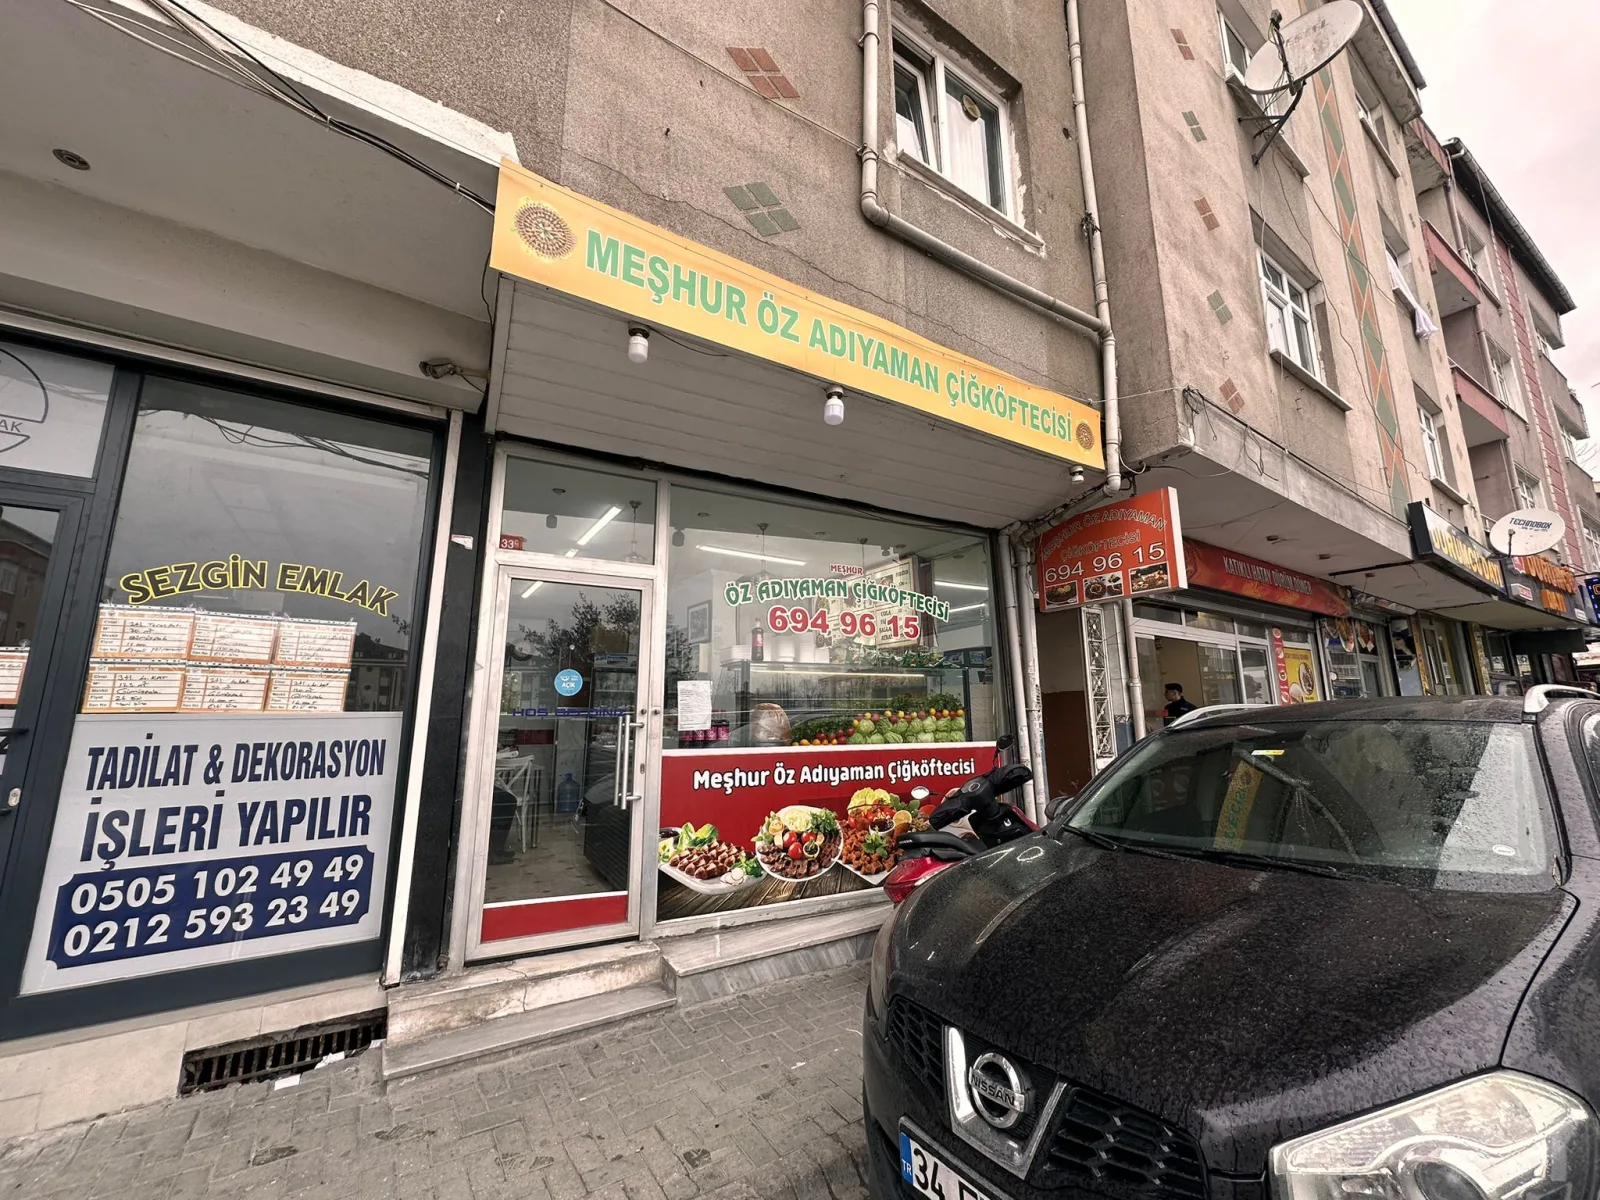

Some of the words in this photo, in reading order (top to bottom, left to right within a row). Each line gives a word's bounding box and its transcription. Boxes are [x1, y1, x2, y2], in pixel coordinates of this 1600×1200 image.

[586, 229, 748, 325] MEŞHUR
[757, 291, 800, 343] ÖZ
[808, 317, 940, 394] ADIYAMAN
[946, 369, 1073, 442] ÇİĞKÖFTECİSİ
[1043, 522, 1083, 560] MEŞHUR
[1083, 513, 1100, 528] ÖZ
[1101, 509, 1165, 532] ADIYAMAN
[1510, 518, 1552, 530] TECHNOBOX
[830, 564, 863, 576] MEŞHUR
[1045, 561, 1084, 582] 694
[1092, 552, 1123, 572] 96
[1133, 542, 1165, 563] 15
[1223, 556, 1251, 579] KATIKLI
[1251, 565, 1272, 584] HATAY
[119, 554, 268, 604] SEZGİN
[277, 563, 399, 616] EMLAK
[724, 581, 752, 607] ÖZ
[757, 578, 848, 602] ADIYAMAN
[851, 580, 950, 623] ÇİĞKÖFTECİSİ
[768, 606, 829, 635] 694
[839, 610, 876, 638] 96
[886, 614, 920, 641] 15
[512, 708, 548, 719] HOŞ
[86, 733, 198, 790] TADİLAT
[203, 744, 223, 785] &
[231, 739, 386, 784] DEKORASYON
[693, 769, 770, 795] Meşhur
[774, 762, 795, 785] Öz
[800, 759, 884, 786] Adıyaman
[888, 757, 975, 784] Çiğköftecisi
[80, 790, 225, 870] İŞLERİ
[237, 794, 372, 847] YAPILIR
[71, 874, 175, 915] 0505
[193, 866, 257, 898] 102
[270, 859, 313, 888] 49
[323, 854, 364, 882] 49
[63, 914, 170, 957] 0212
[183, 903, 253, 939] 593
[264, 895, 307, 927] 23
[319, 889, 360, 918] 49
[971, 1072, 1015, 1106] NISSAN
[902, 1158, 911, 1176] TR
